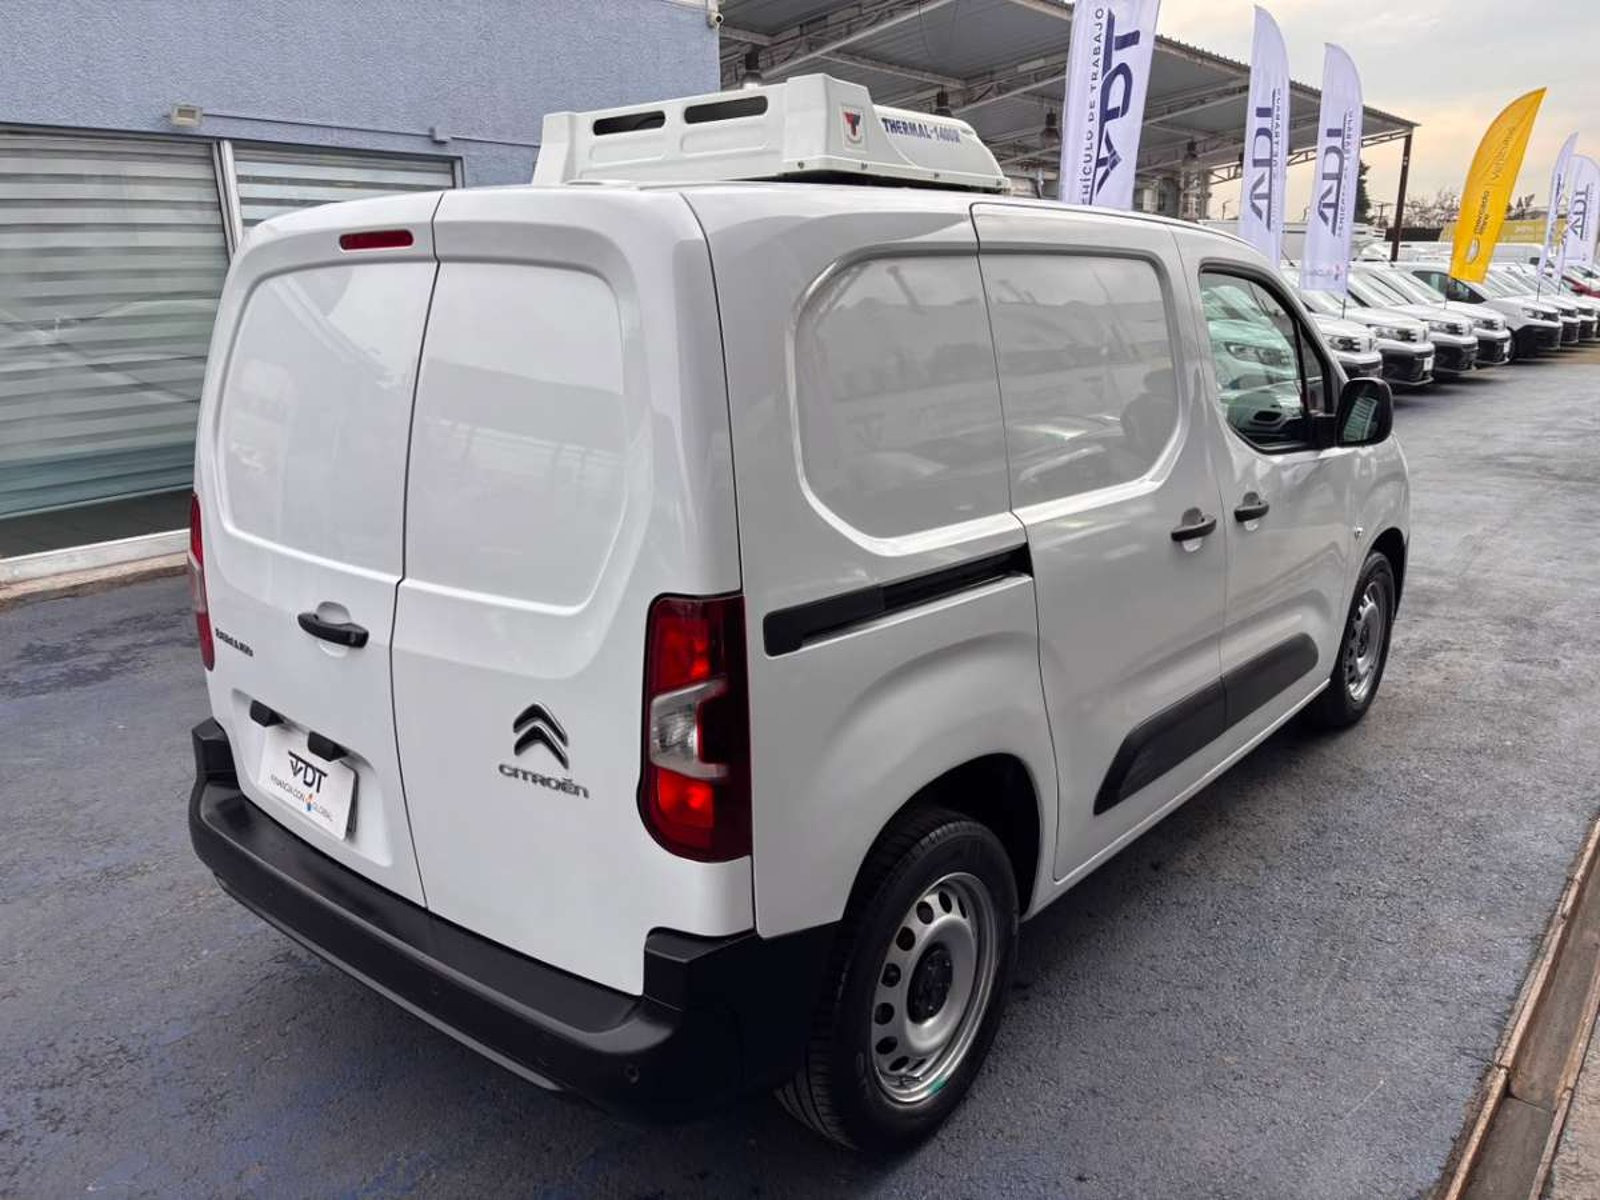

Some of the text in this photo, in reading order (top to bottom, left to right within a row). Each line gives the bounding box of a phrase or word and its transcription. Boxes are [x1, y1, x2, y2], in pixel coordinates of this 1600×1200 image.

[1090, 8, 1105, 94] TRABAJO
[1087, 99, 1097, 123] DE
[1089, 8, 1141, 206] VDT
[288, 750, 328, 794] VDT
